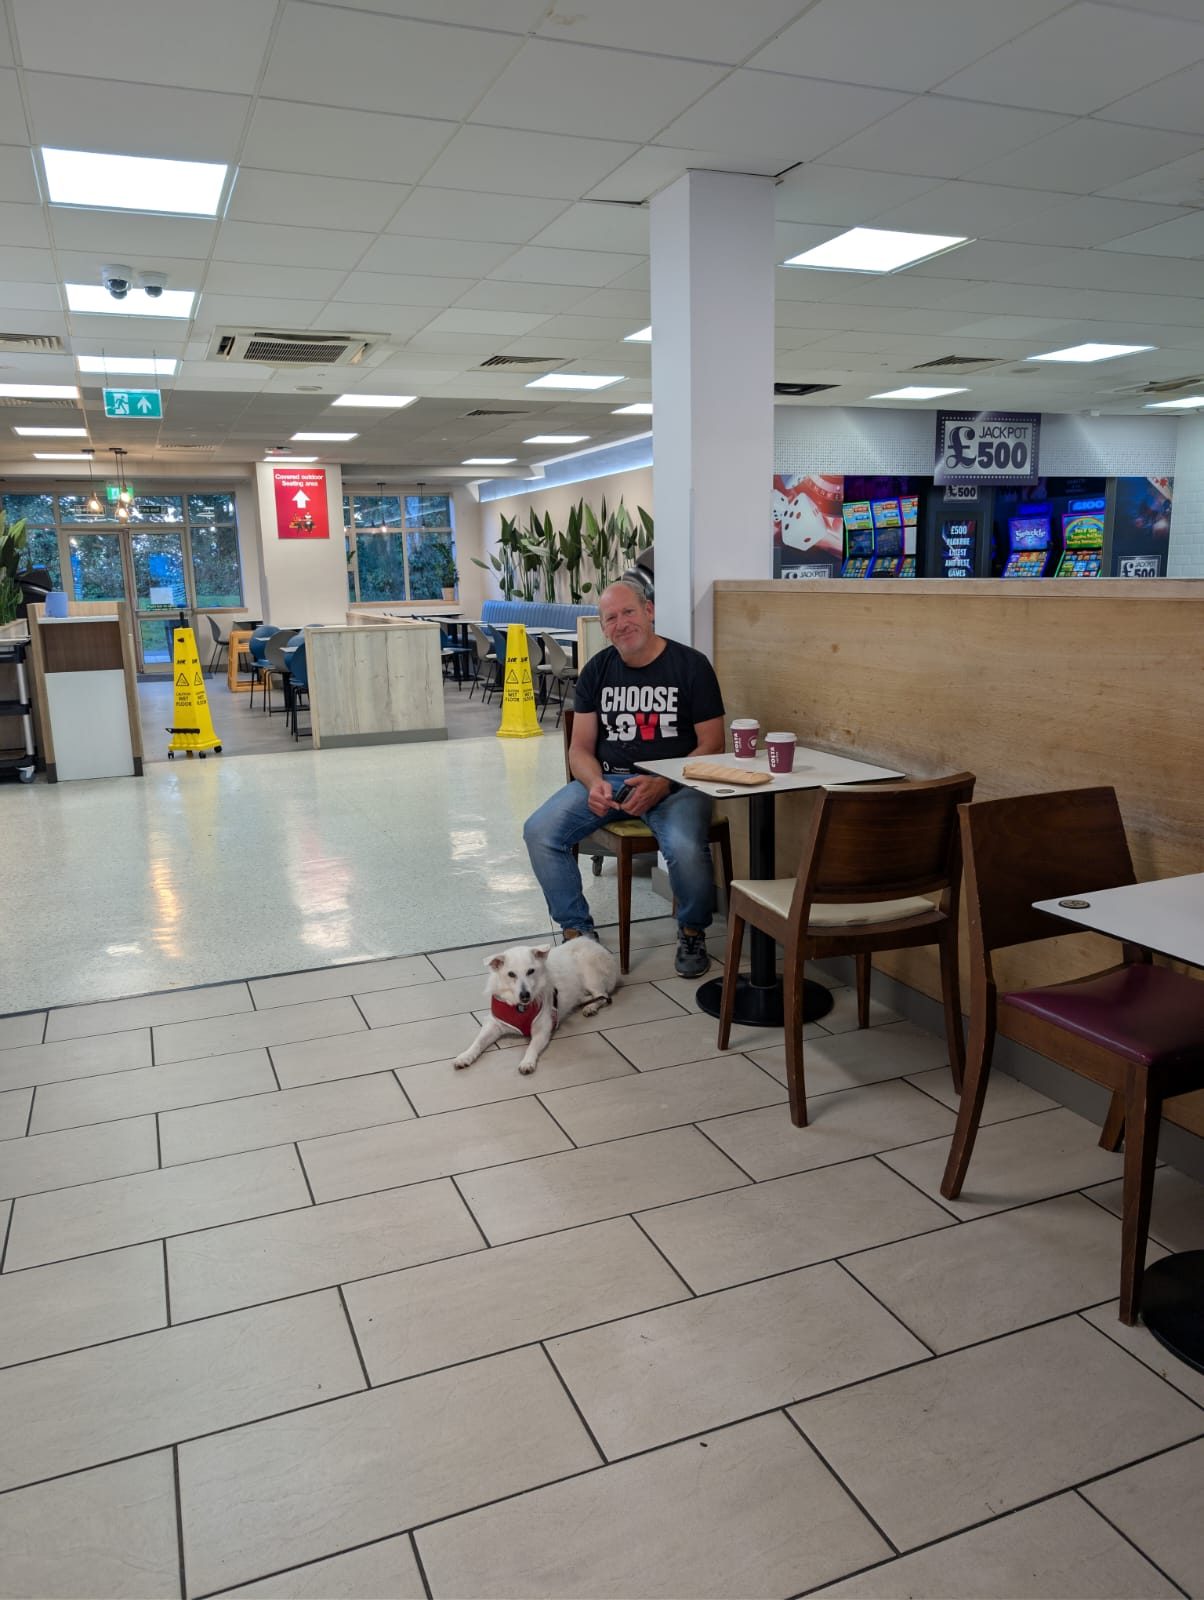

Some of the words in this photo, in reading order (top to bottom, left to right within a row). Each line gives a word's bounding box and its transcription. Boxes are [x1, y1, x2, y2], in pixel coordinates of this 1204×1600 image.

[979, 426, 1028, 439] JACKPOT
[946, 426, 1028, 469] £500
[951, 525, 967, 535] £500
[800, 570, 827, 578] JACKPOT
[948, 569, 966, 577] GAMES
[601, 686, 679, 712] CHOOSE
[601, 713, 679, 741] LOVE
